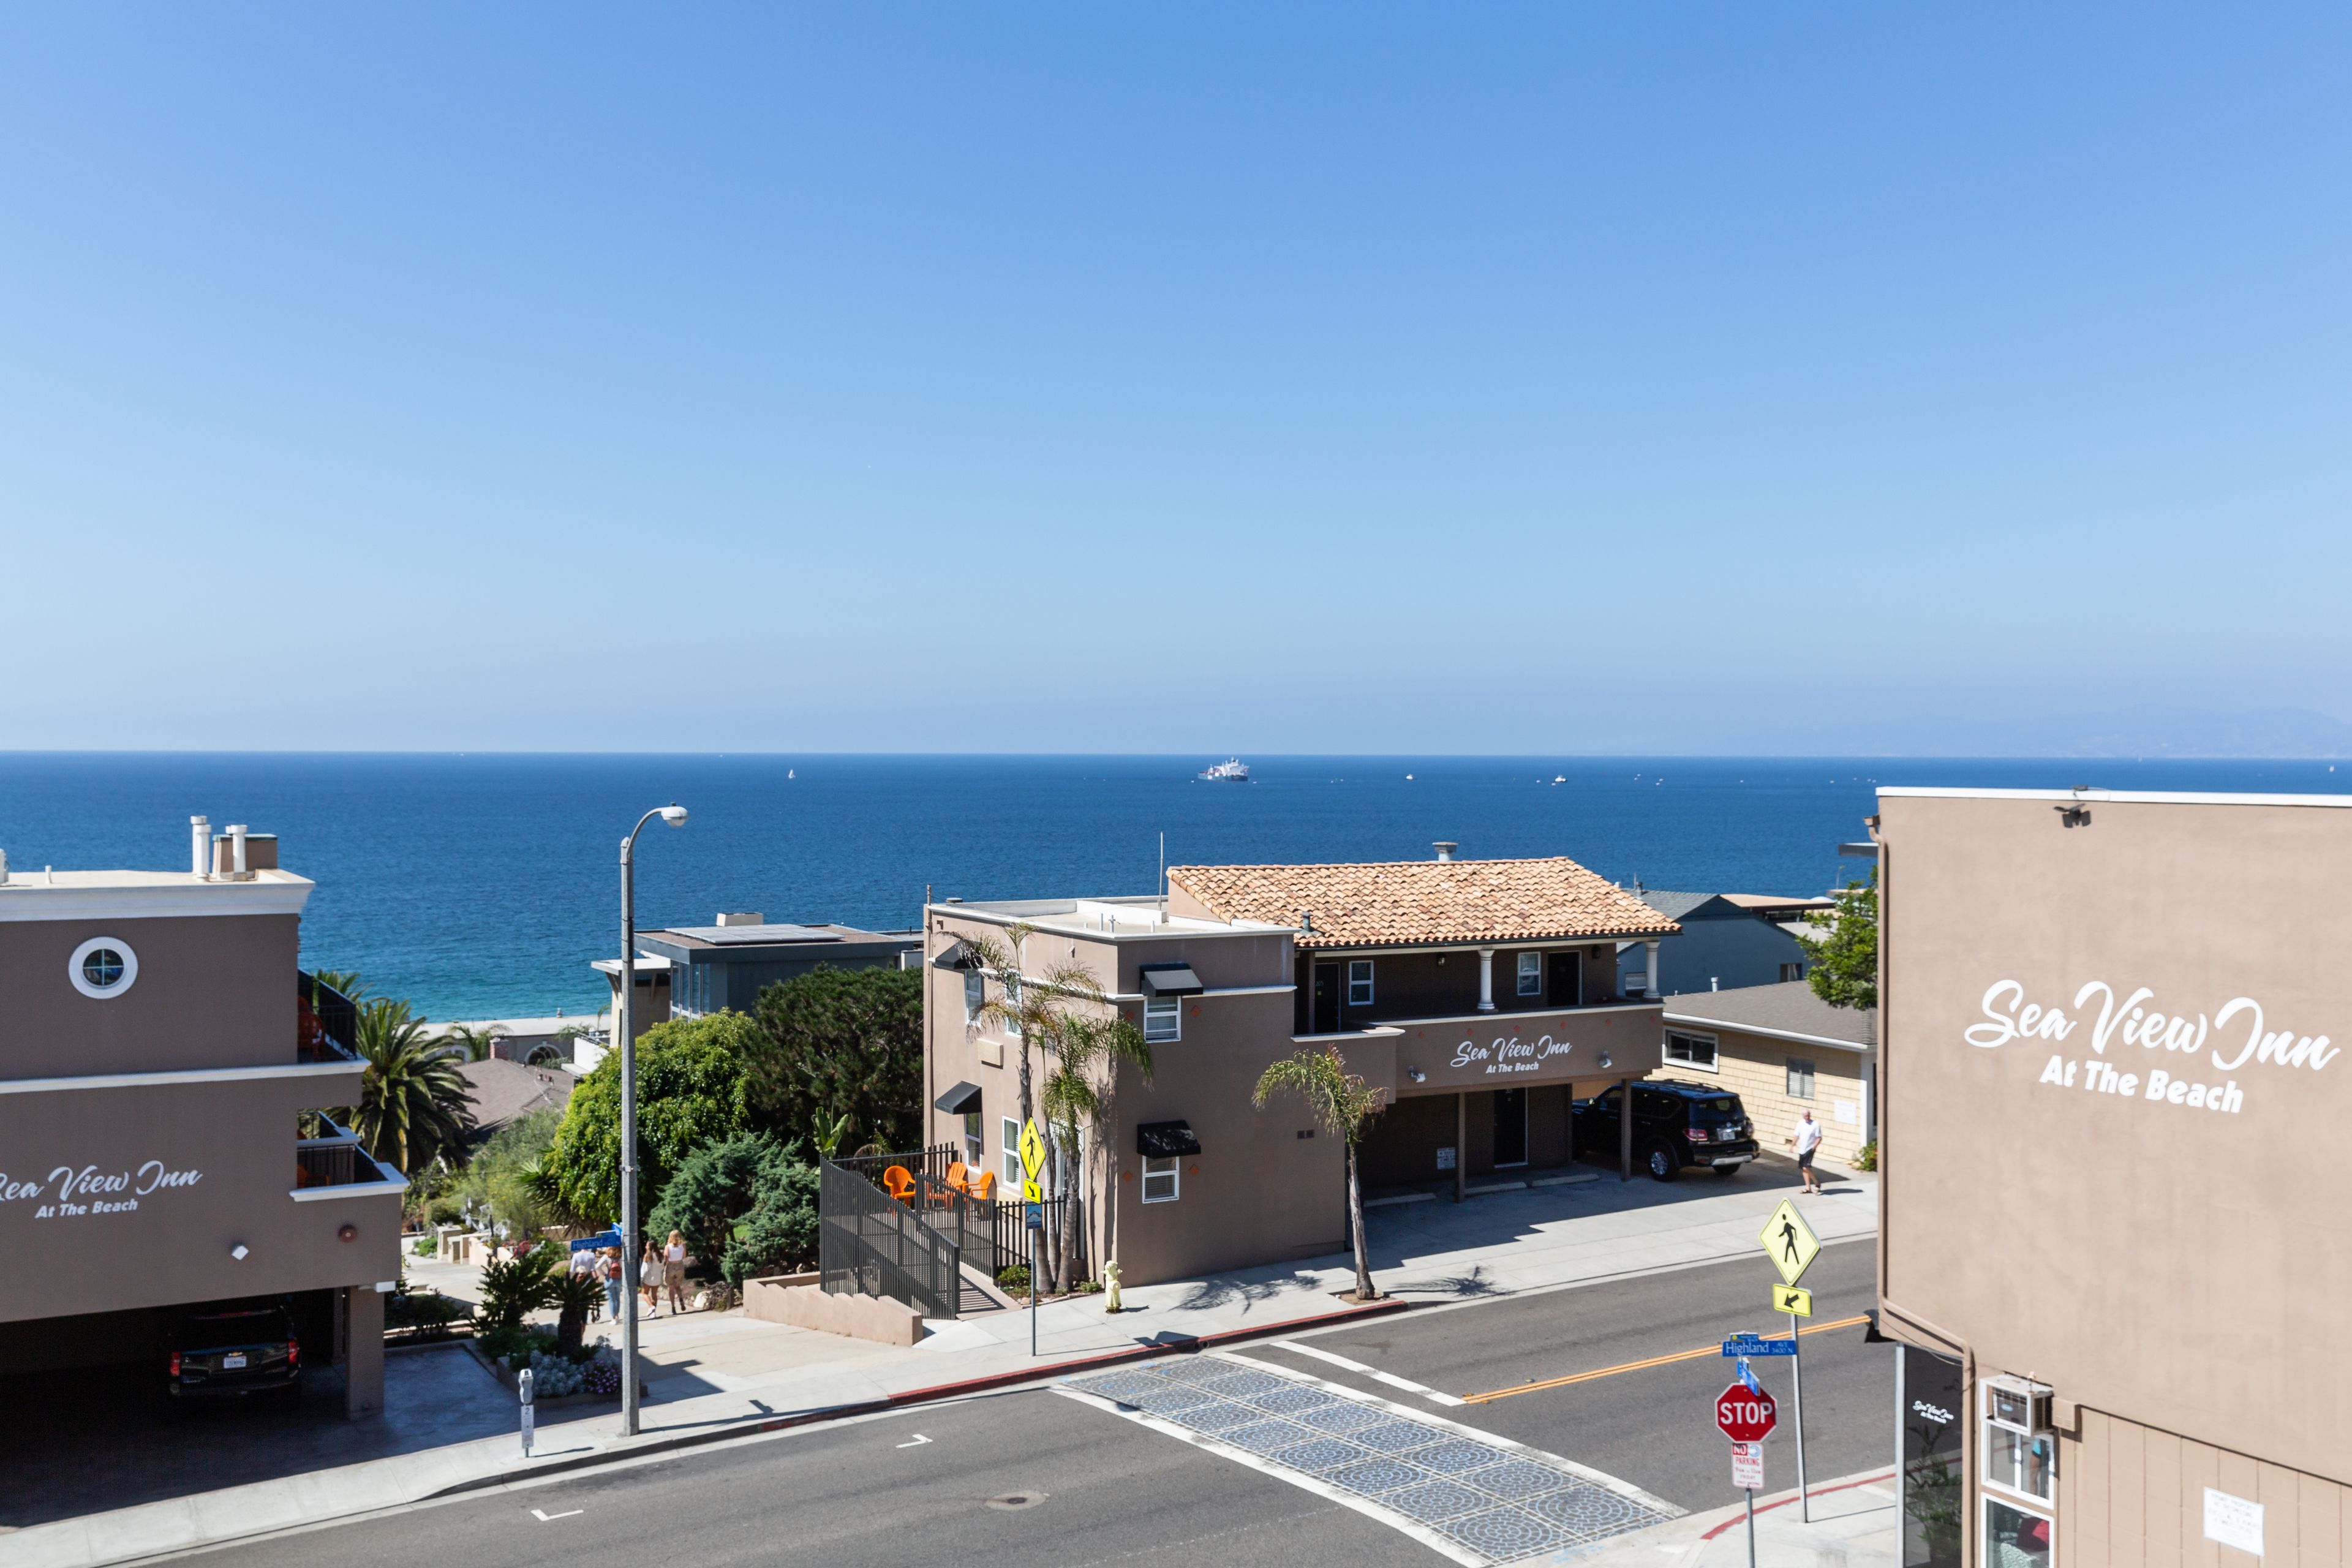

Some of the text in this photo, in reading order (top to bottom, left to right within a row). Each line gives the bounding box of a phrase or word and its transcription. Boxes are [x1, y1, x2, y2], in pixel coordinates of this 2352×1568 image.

[1964, 979, 2342, 1071] Sea View Inn
[1450, 1035, 1573, 1068] Sea View Inn
[1485, 1061, 1539, 1074] At The Beach
[2038, 1055, 2244, 1114] At The Beach
[0, 1160, 203, 1202] ea View Inn
[34, 1198, 139, 1219] At The Beach
[573, 1238, 603, 1249] Highland
[1725, 1341, 1770, 1355] Highland
[1720, 1401, 1773, 1425] STOP
[1733, 1444, 1747, 1455] NO
[1735, 1457, 1760, 1466] PARKING
